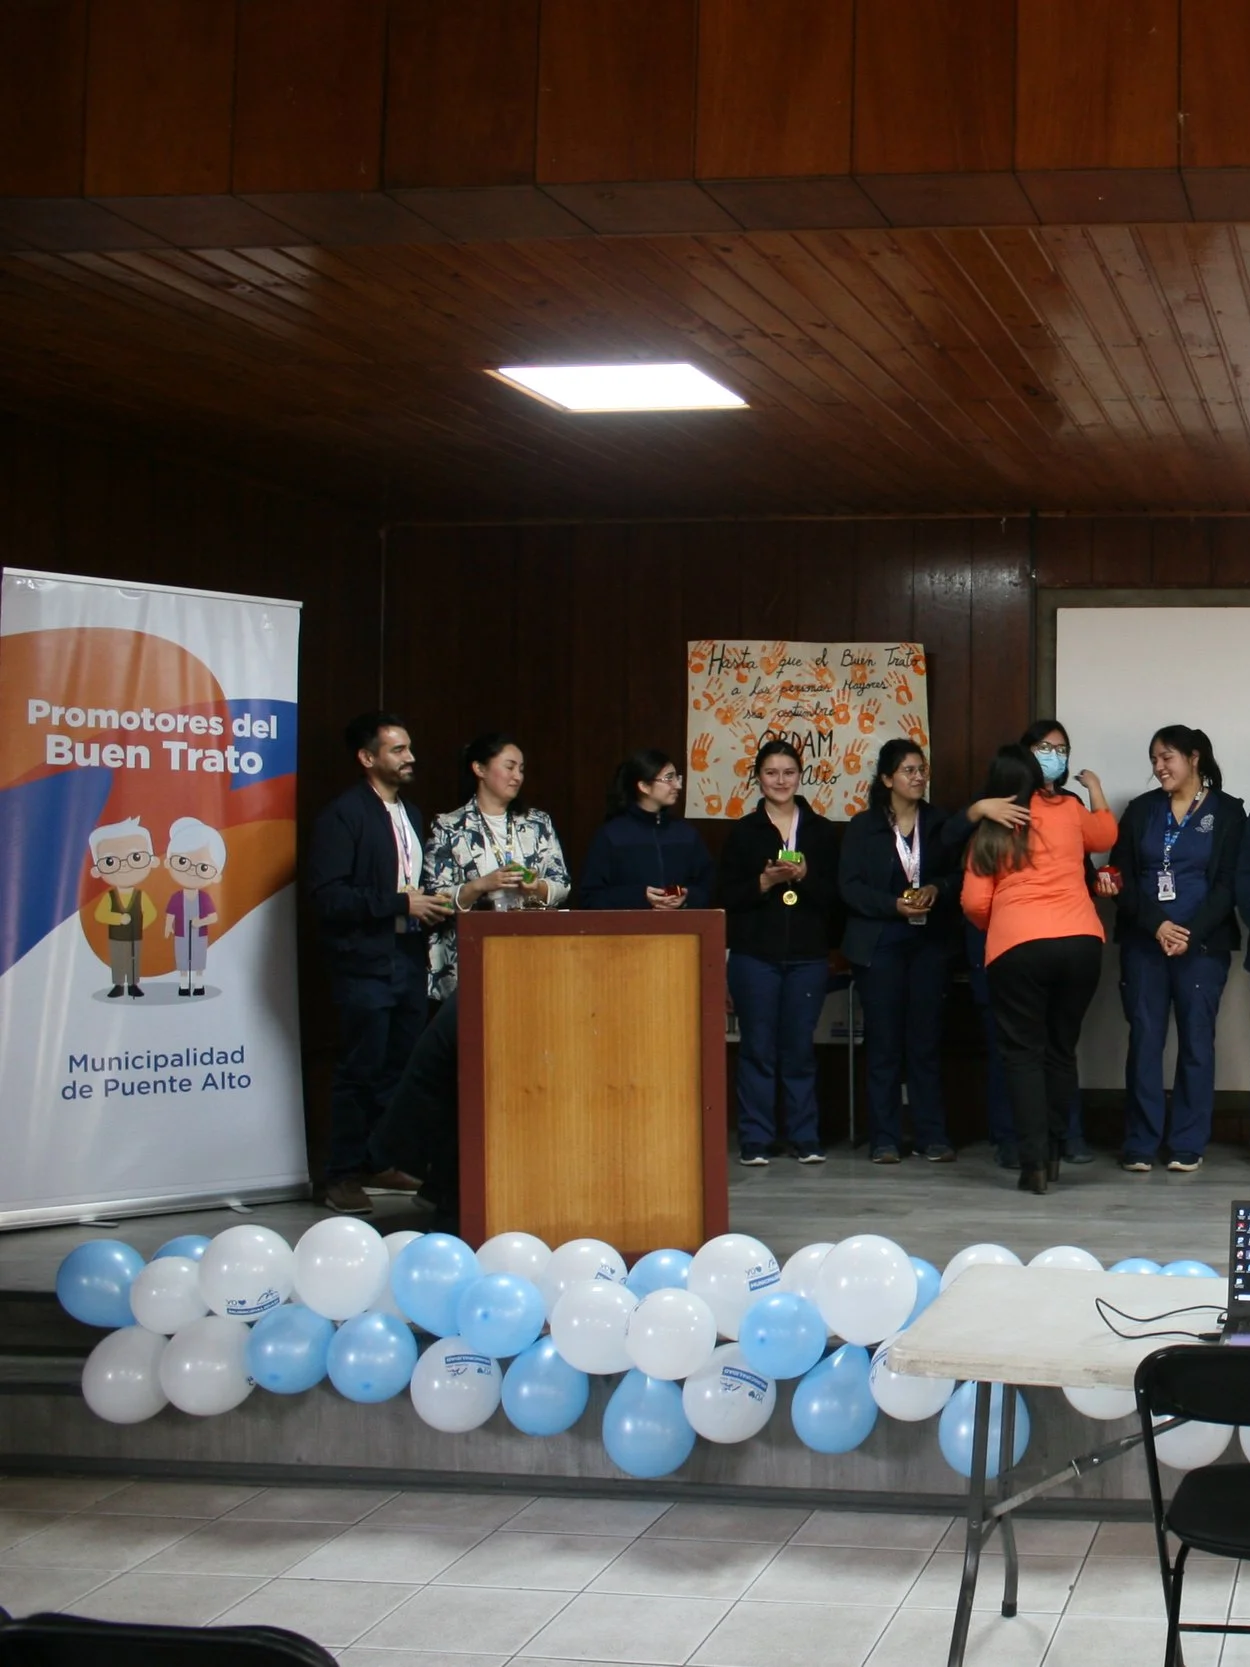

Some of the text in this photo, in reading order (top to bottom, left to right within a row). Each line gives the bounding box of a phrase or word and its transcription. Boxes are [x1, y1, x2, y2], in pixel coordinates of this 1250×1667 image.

[708, 643, 919, 679] Hasta que el Buen Trato
[731, 686, 742, 697] a
[749, 677, 771, 697] las
[778, 681, 833, 703] personas
[28, 698, 279, 740] Promotores del
[46, 734, 263, 775] Buen Trato
[801, 764, 842, 786] Alto
[69, 1045, 245, 1073] Municipalidad
[61, 1071, 251, 1100] de Puente Alto
